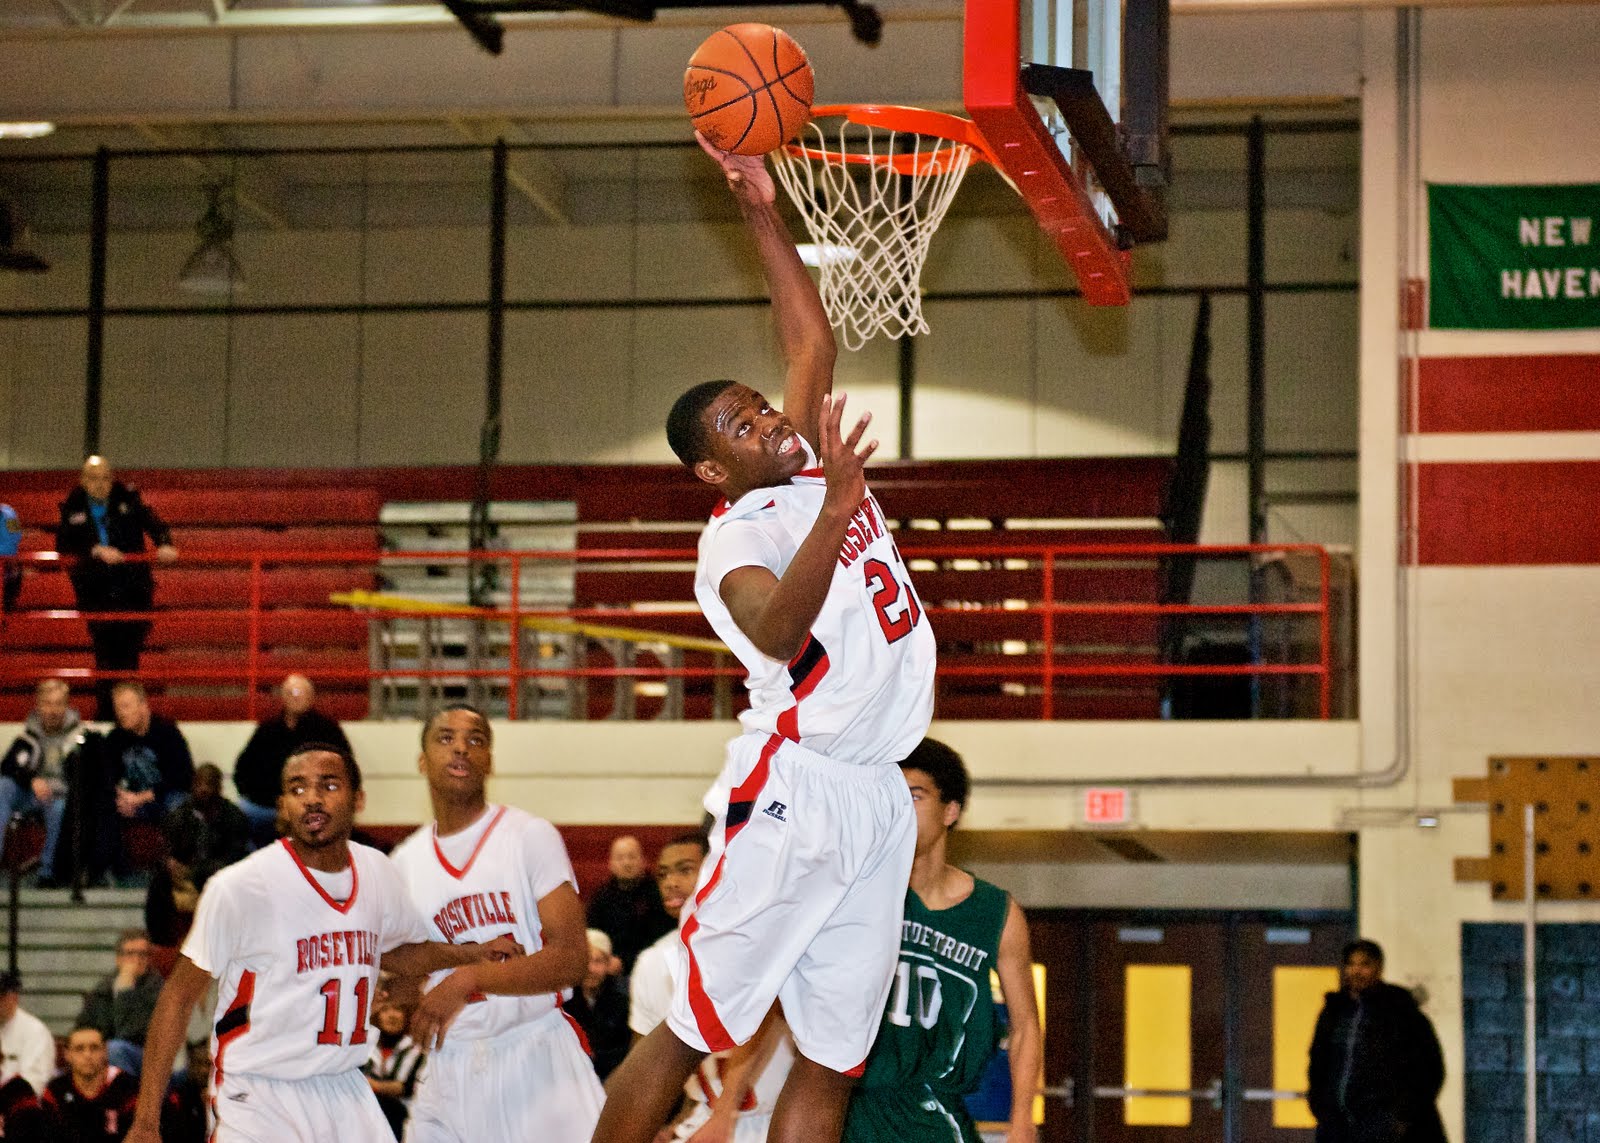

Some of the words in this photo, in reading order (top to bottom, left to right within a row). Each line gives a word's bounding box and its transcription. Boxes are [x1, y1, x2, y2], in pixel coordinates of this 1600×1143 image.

[1519, 216, 1592, 246] NEW
[317, 976, 369, 1046] 11
[887, 961, 943, 1030] 10
